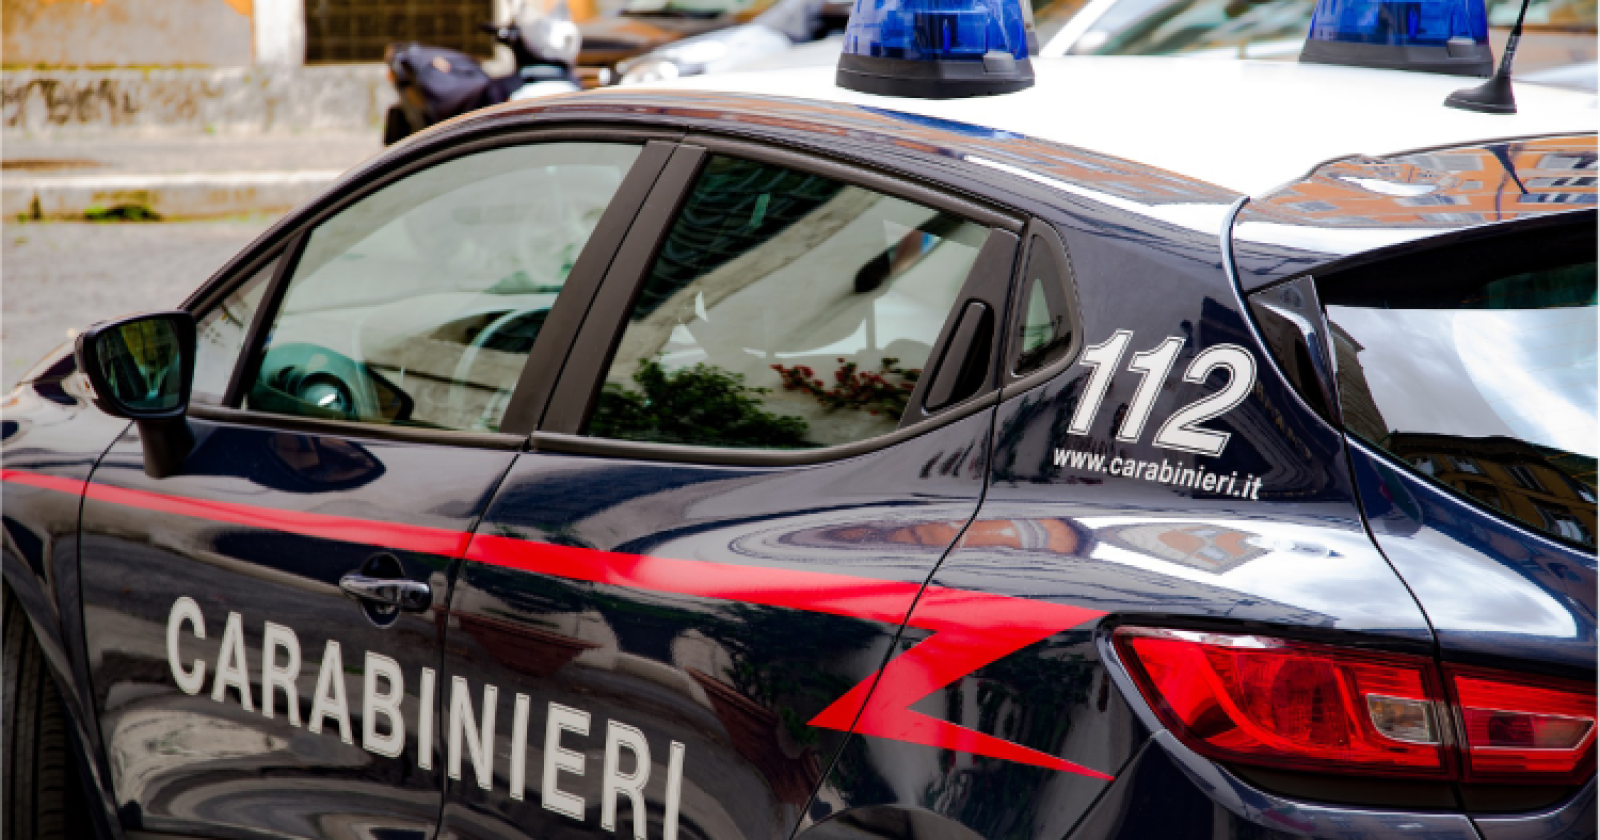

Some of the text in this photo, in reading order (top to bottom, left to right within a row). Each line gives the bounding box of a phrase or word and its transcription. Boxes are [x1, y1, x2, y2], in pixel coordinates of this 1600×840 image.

[1067, 328, 1257, 457] 112
[1053, 447, 1263, 500] www.carabinieri.it
[166, 596, 686, 840] CARABINIERI
